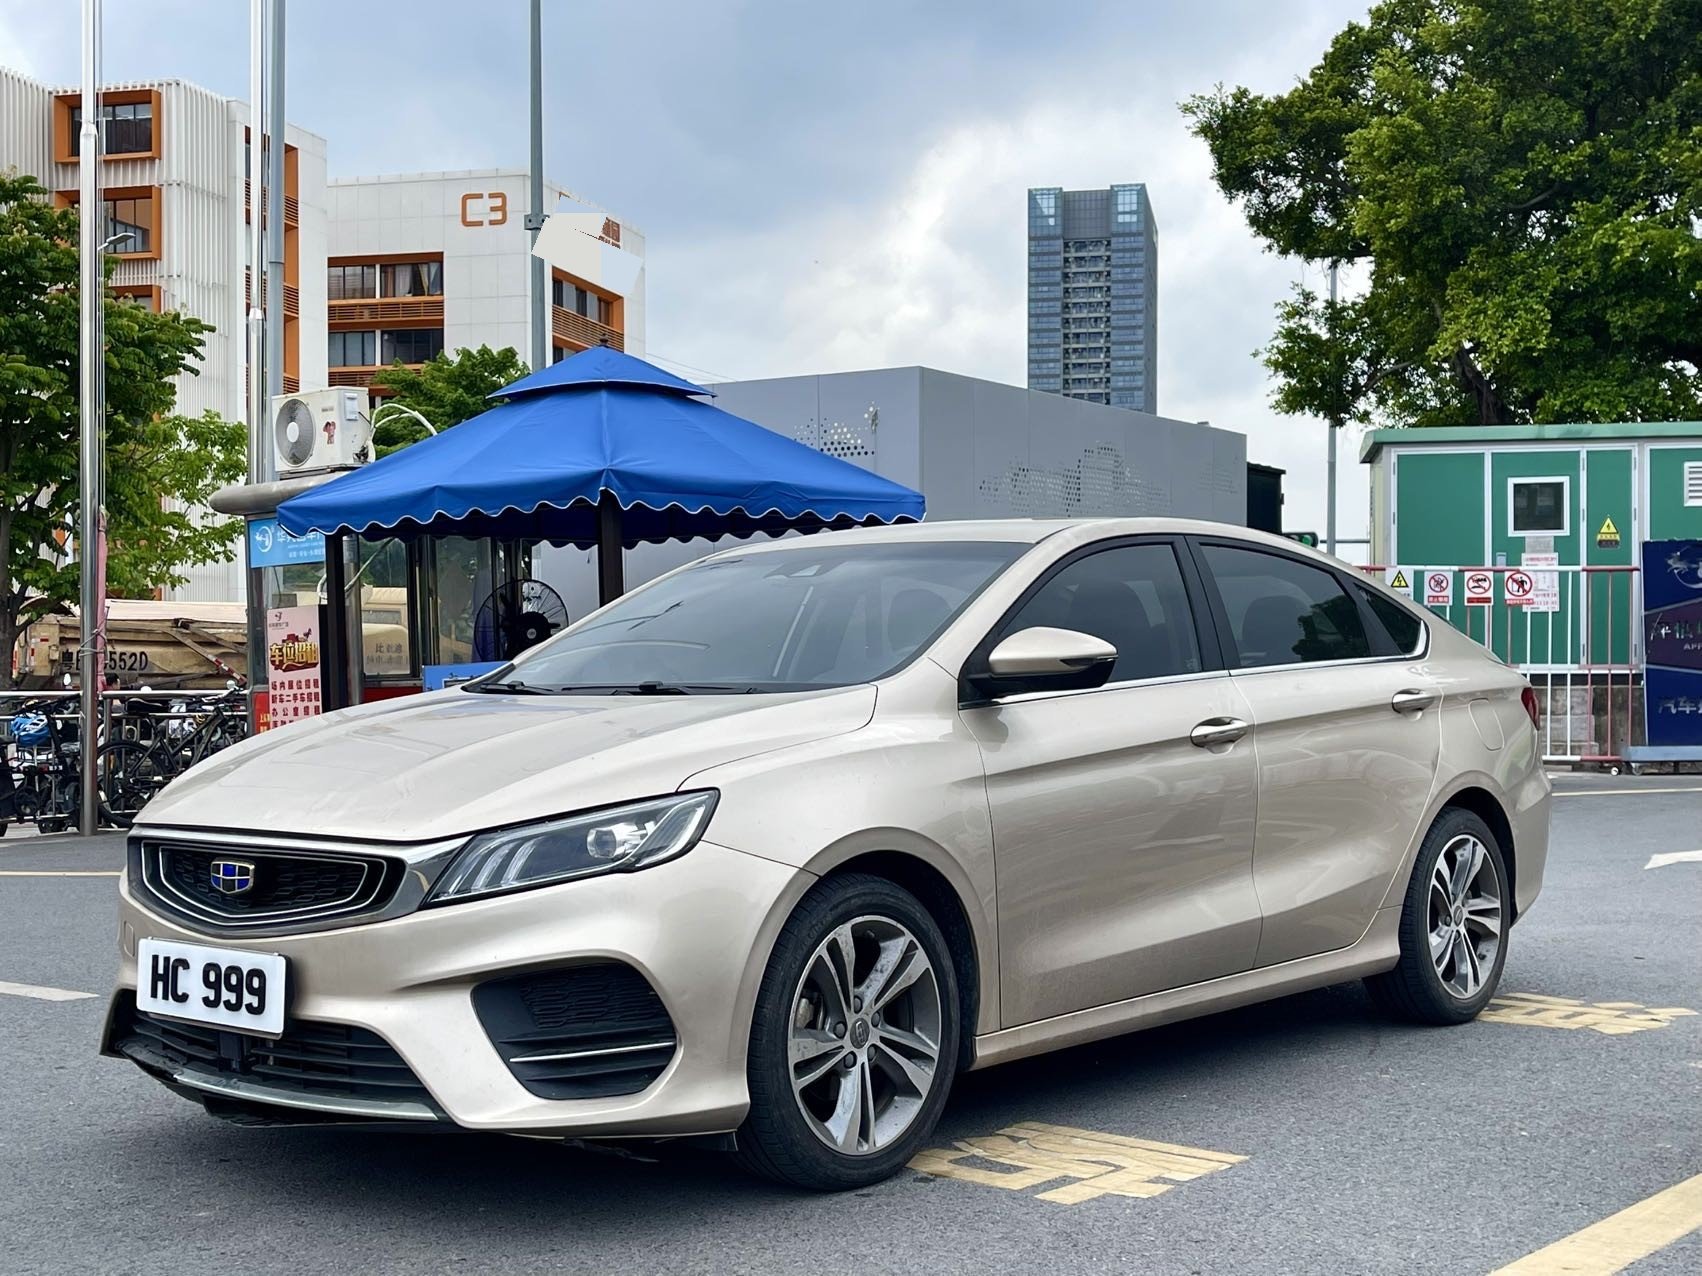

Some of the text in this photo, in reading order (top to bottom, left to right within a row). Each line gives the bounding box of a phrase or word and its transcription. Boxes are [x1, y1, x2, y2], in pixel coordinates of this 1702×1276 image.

[461, 192, 507, 227] C3
[270, 641, 319, 665] 车位招租
[150, 954, 267, 1015] HC 999
